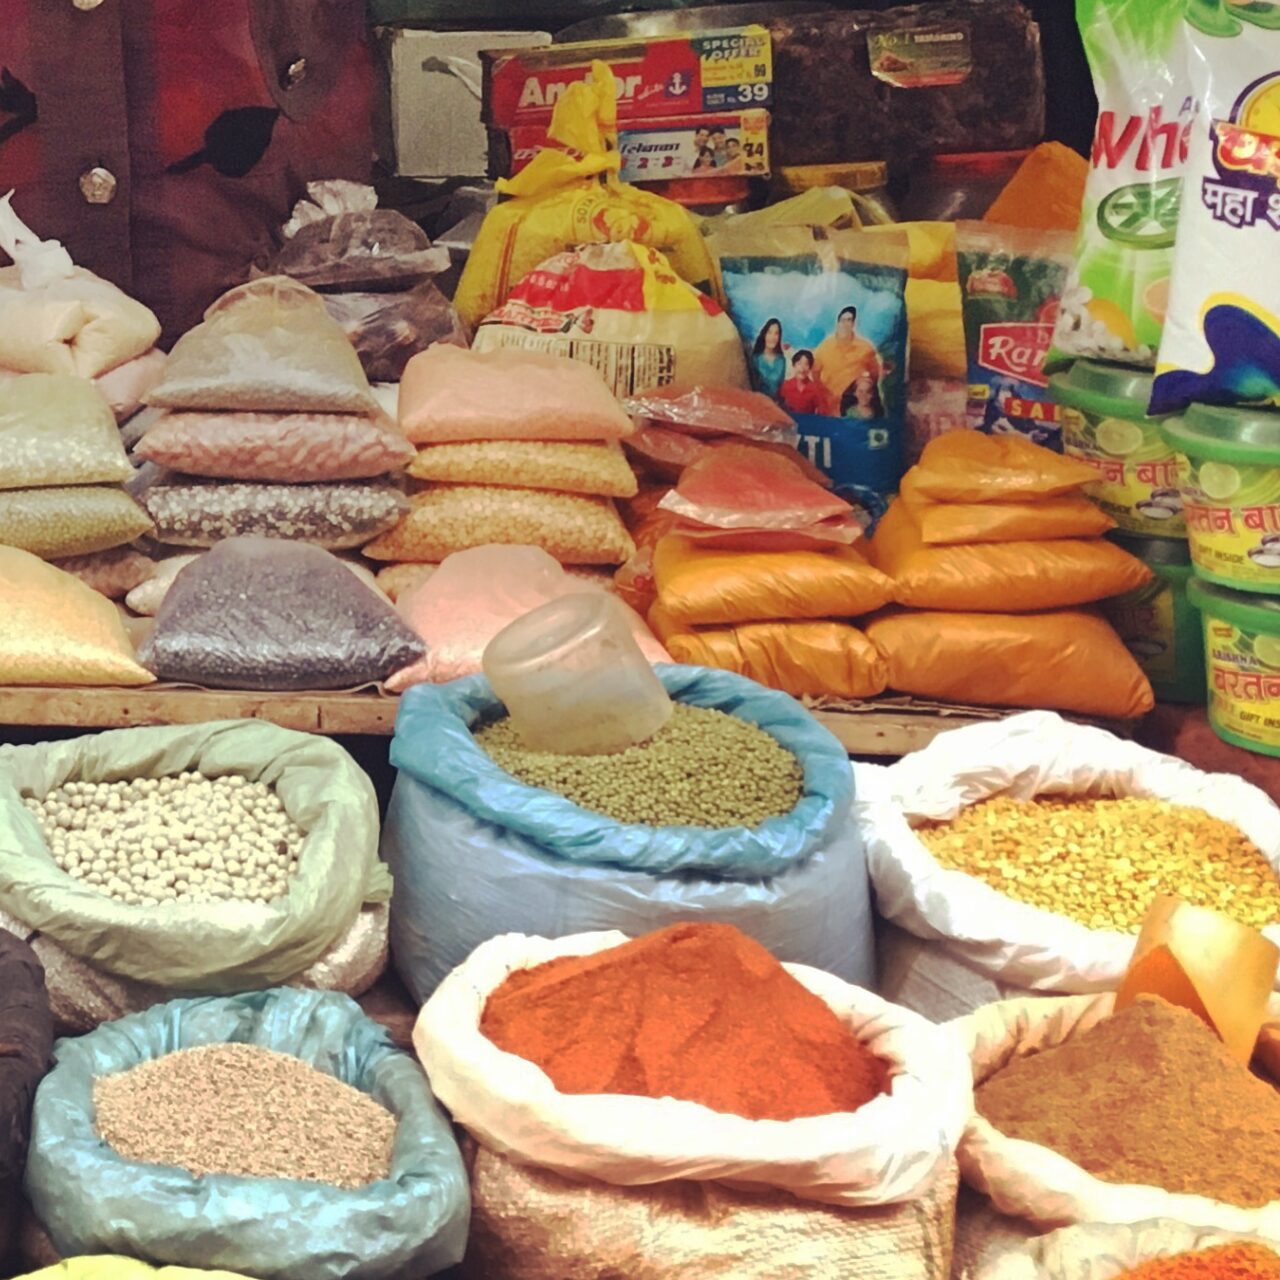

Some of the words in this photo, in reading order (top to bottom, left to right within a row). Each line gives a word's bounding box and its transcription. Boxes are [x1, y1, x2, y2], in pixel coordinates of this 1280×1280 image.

[702, 37, 765, 50] SPECIAL
[518, 66, 642, 108] Anor
[738, 83, 770, 103] 39
[1204, 181, 1260, 228] महा
